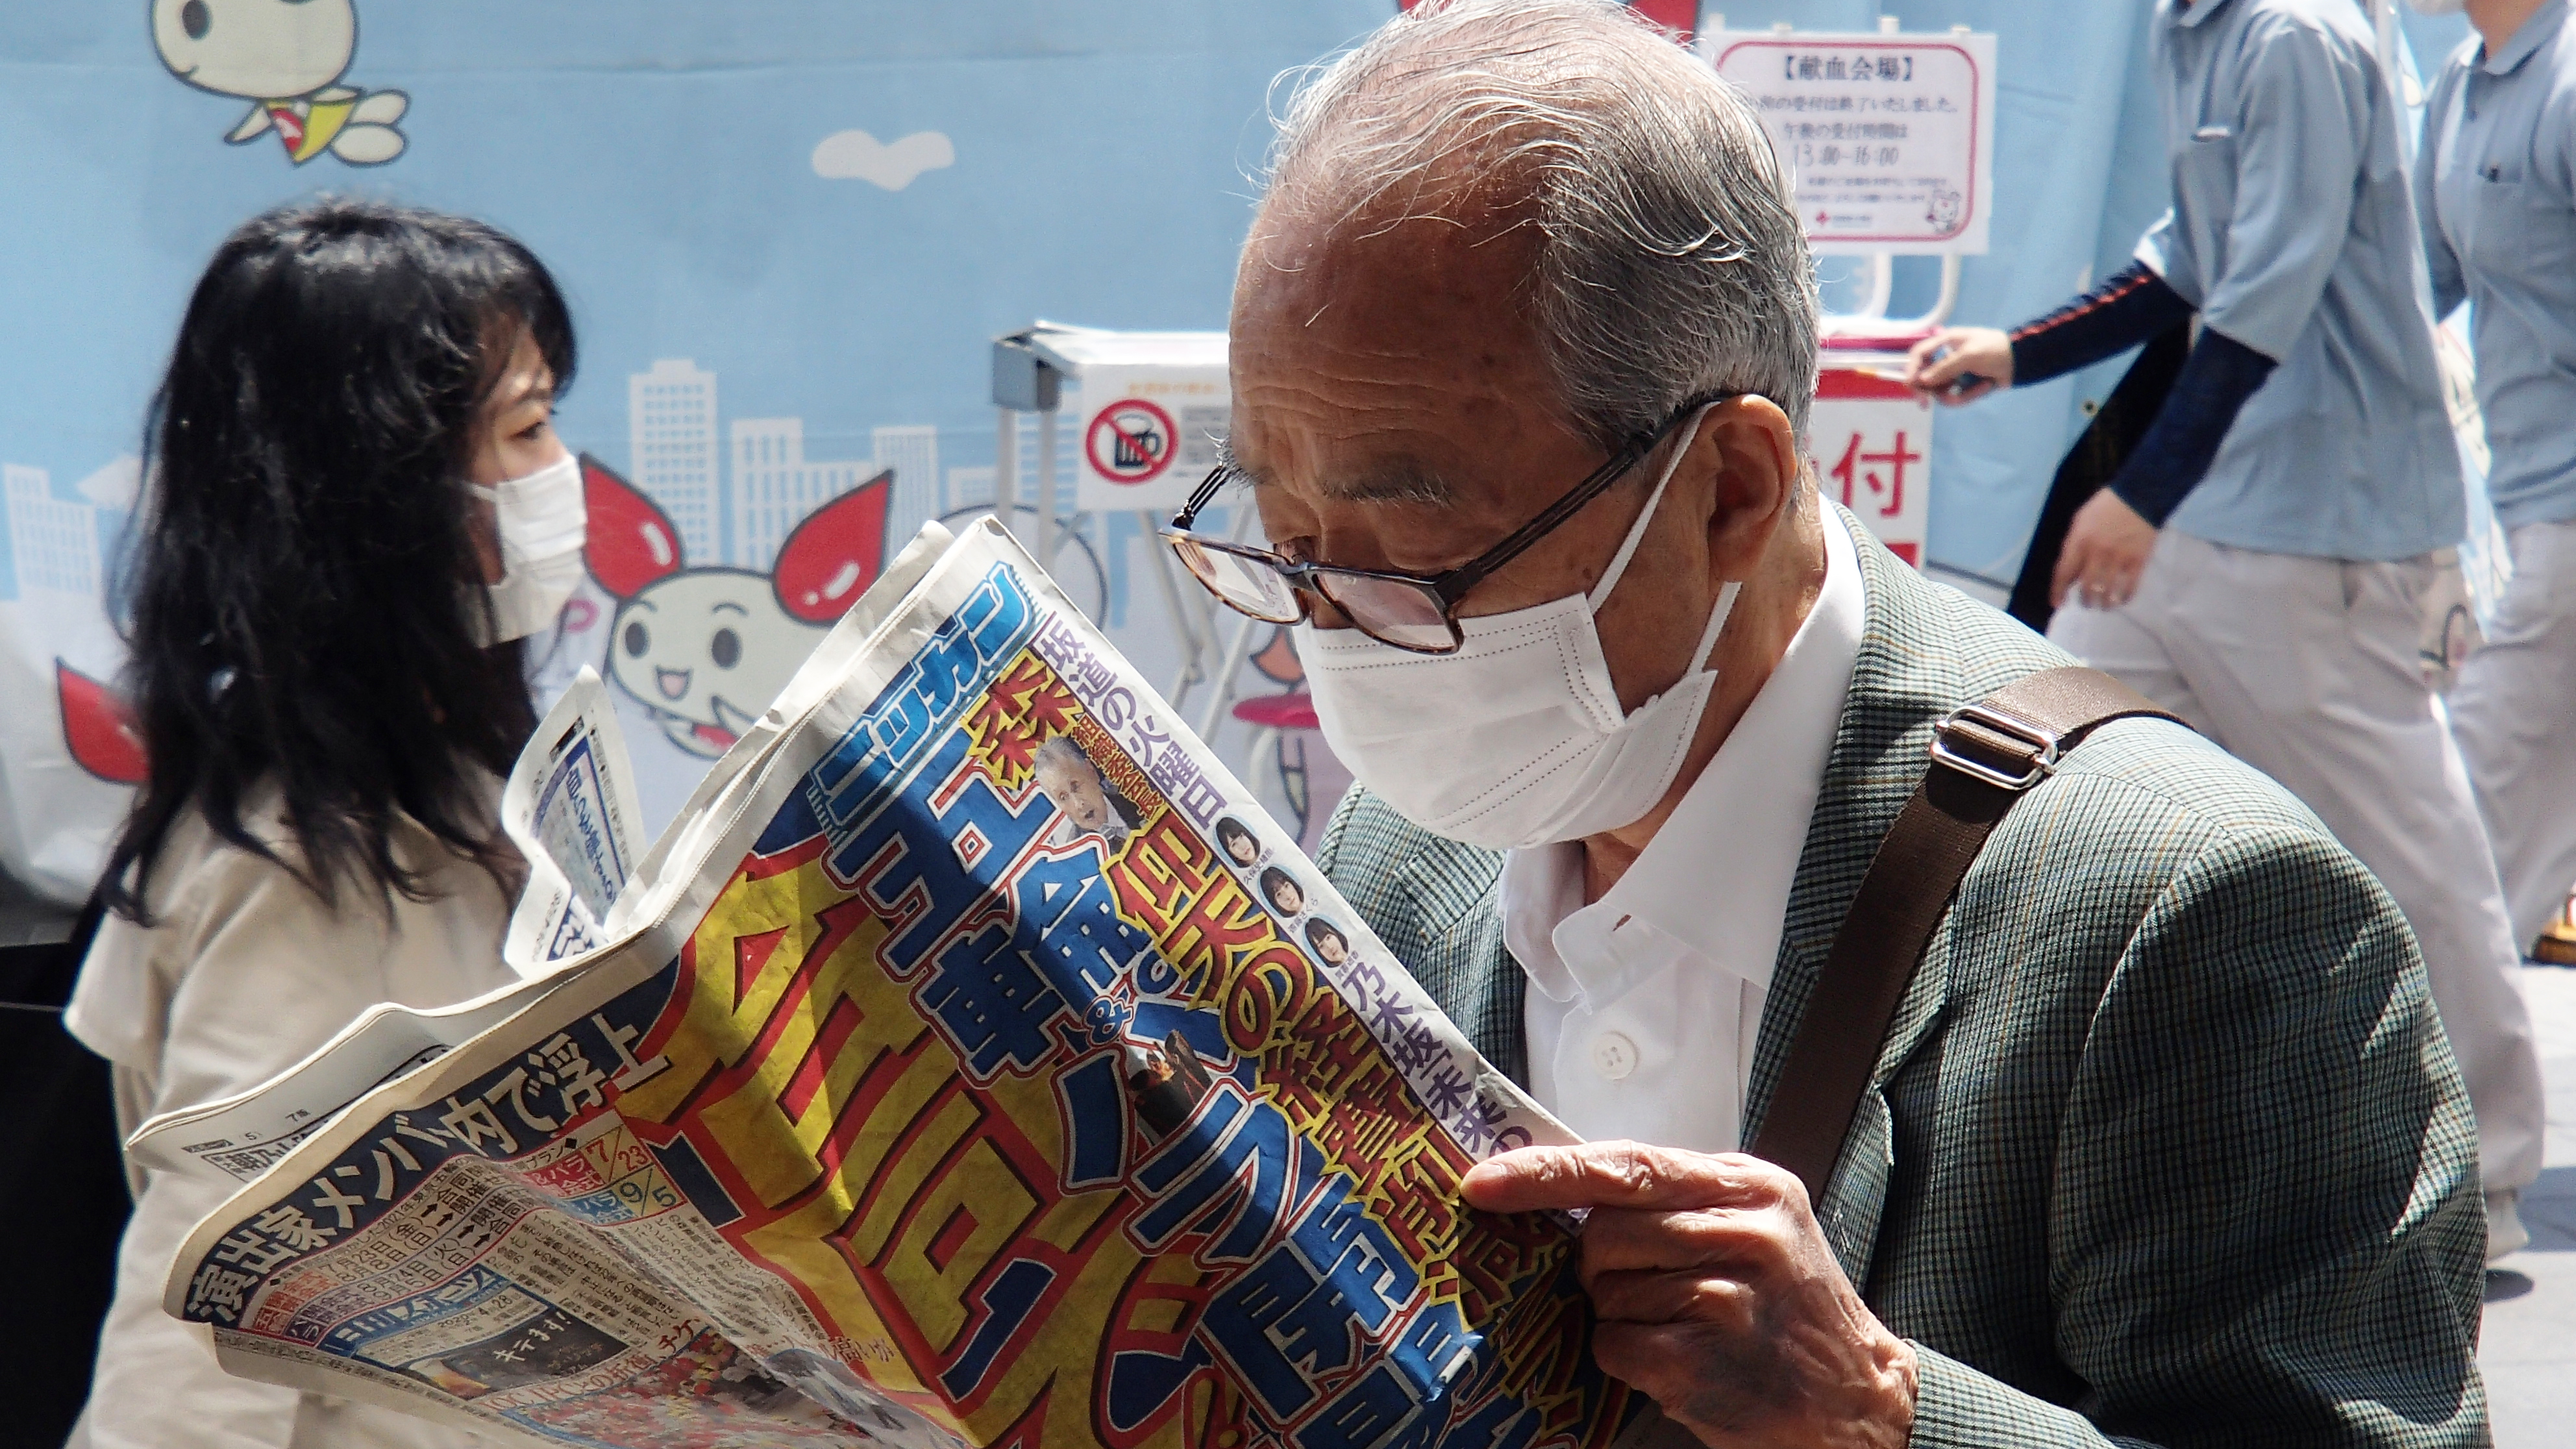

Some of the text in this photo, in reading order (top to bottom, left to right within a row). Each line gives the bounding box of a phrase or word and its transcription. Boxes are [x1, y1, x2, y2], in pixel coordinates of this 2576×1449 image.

[1785, 55, 1913, 81] 【献血会場】
[1805, 431, 1922, 517] 付
[810, 565, 1034, 827] ニッカン
[964, 650, 1079, 787] 森
[1037, 620, 1228, 830] 坂道の火曜日
[1072, 716, 1164, 819] 組織委会長
[585, 1128, 649, 1182] 7/23
[617, 1166, 678, 1213] 9/5
